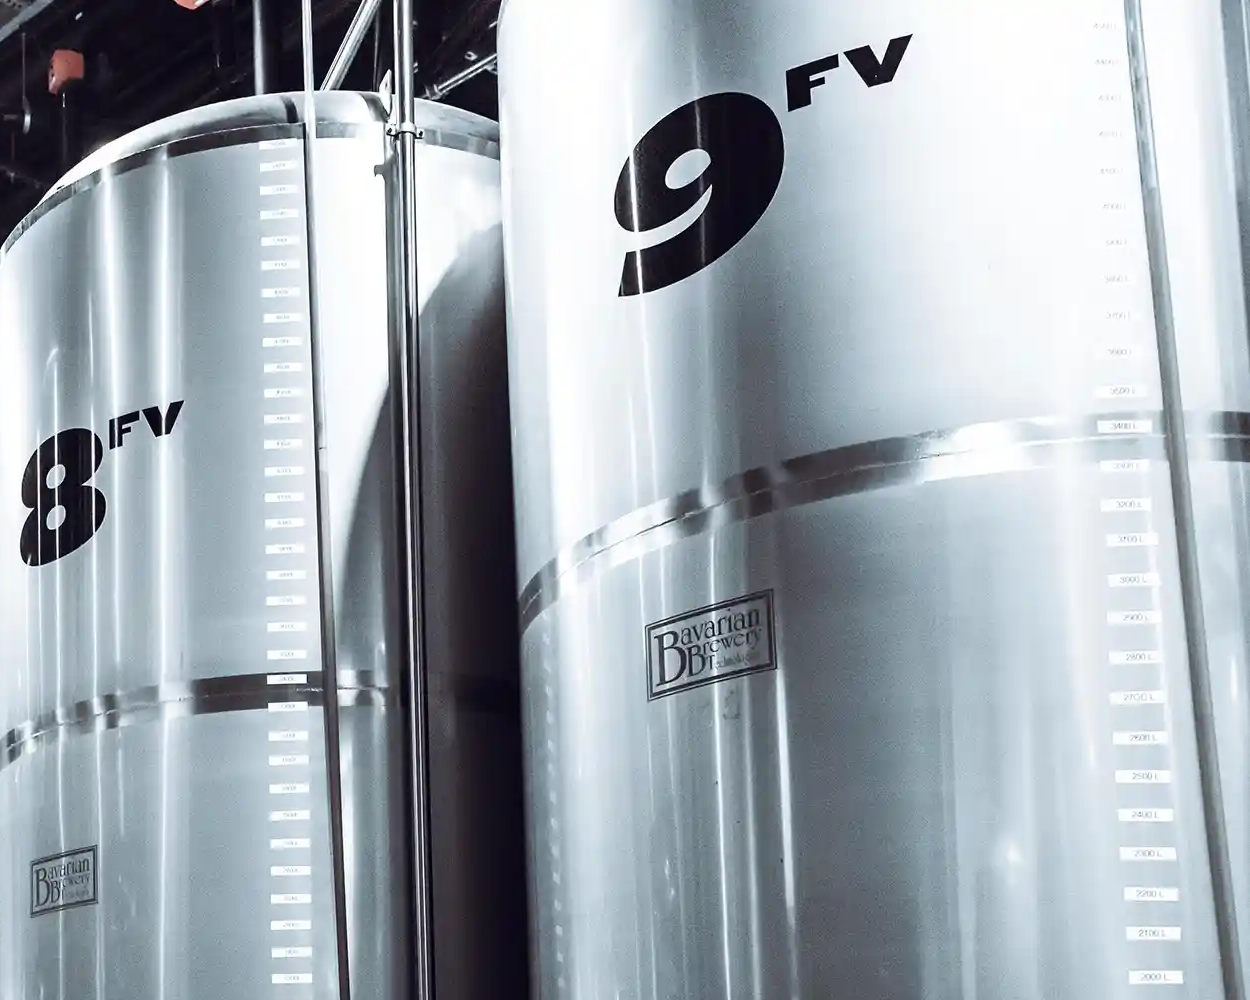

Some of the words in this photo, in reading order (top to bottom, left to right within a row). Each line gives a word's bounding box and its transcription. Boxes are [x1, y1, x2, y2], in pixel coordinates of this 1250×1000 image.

[613, 91, 785, 298] 9
[785, 33, 913, 112] FV
[20, 427, 107, 567] 8
[109, 399, 185, 450] FV
[1115, 500, 1136, 508] 3200
[1119, 575, 1140, 584] 3000
[653, 608, 760, 687] Bavarian
[686, 629, 758, 678] Brewery
[1123, 692, 1148, 701] 2700
[1132, 772, 1153, 780] 2500
[1131, 810, 1152, 818] 2400
[1136, 889, 1156, 898] 2200
[1138, 929, 1159, 937] 2100
[1141, 973, 1162, 981] 2000
